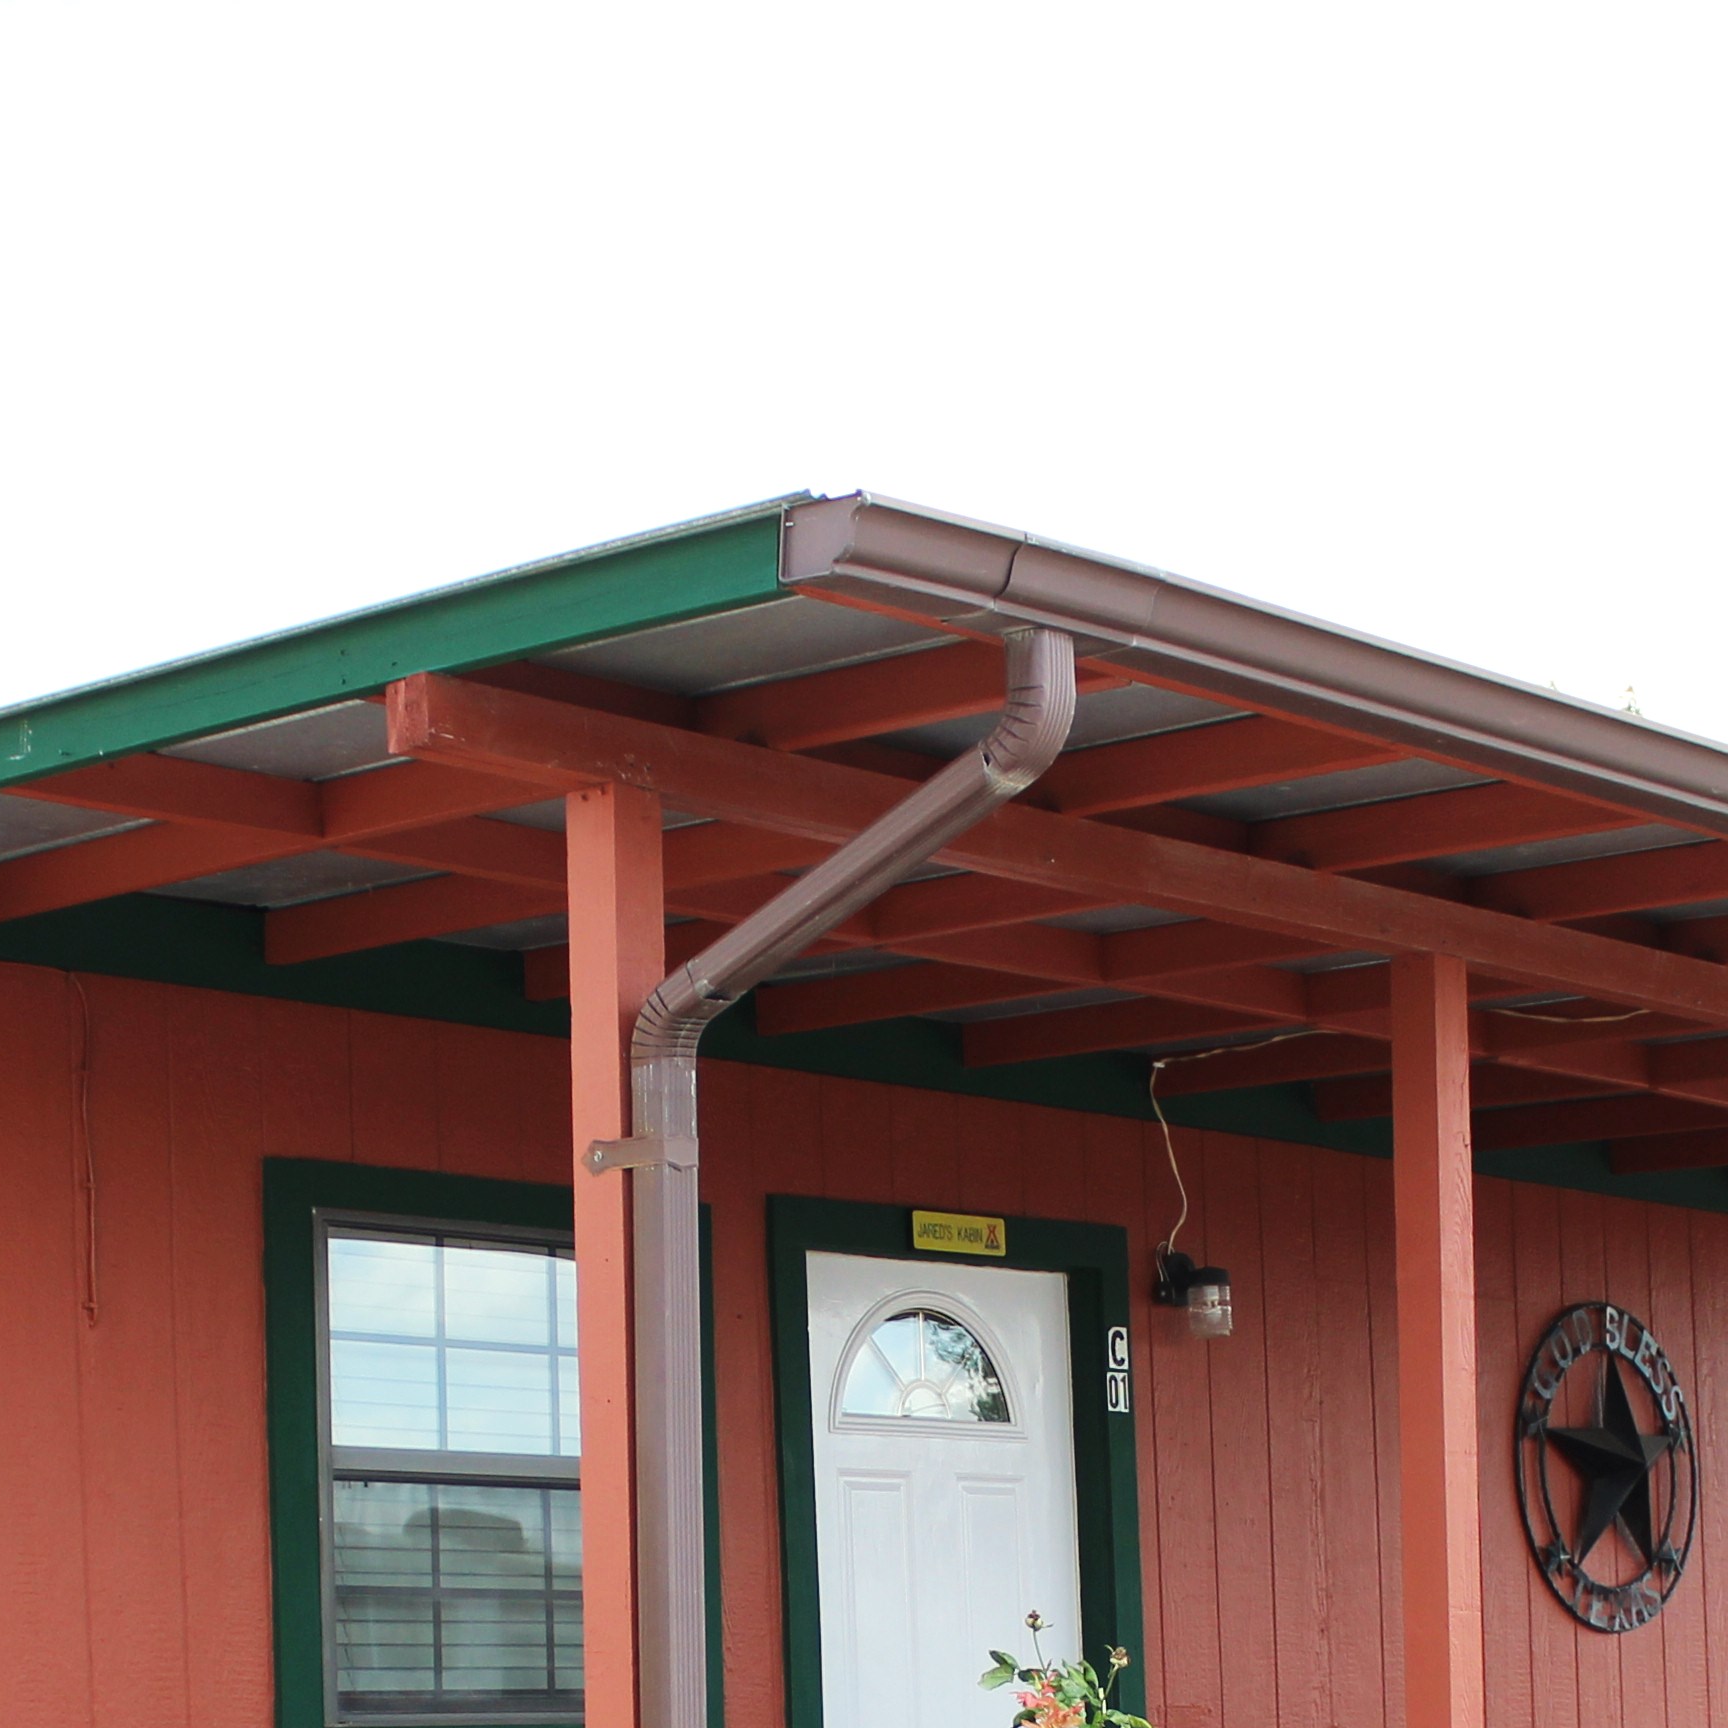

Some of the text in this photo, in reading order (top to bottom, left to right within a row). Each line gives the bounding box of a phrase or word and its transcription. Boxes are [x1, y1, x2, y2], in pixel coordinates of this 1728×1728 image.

[957, 1226, 983, 1243] KABIN
[1111, 1330, 1125, 1366] C
[1532, 1306, 1684, 1420] GOD BLESS
[1109, 1374, 1128, 1409] 01
[1573, 1570, 1664, 1631] TEXAS
